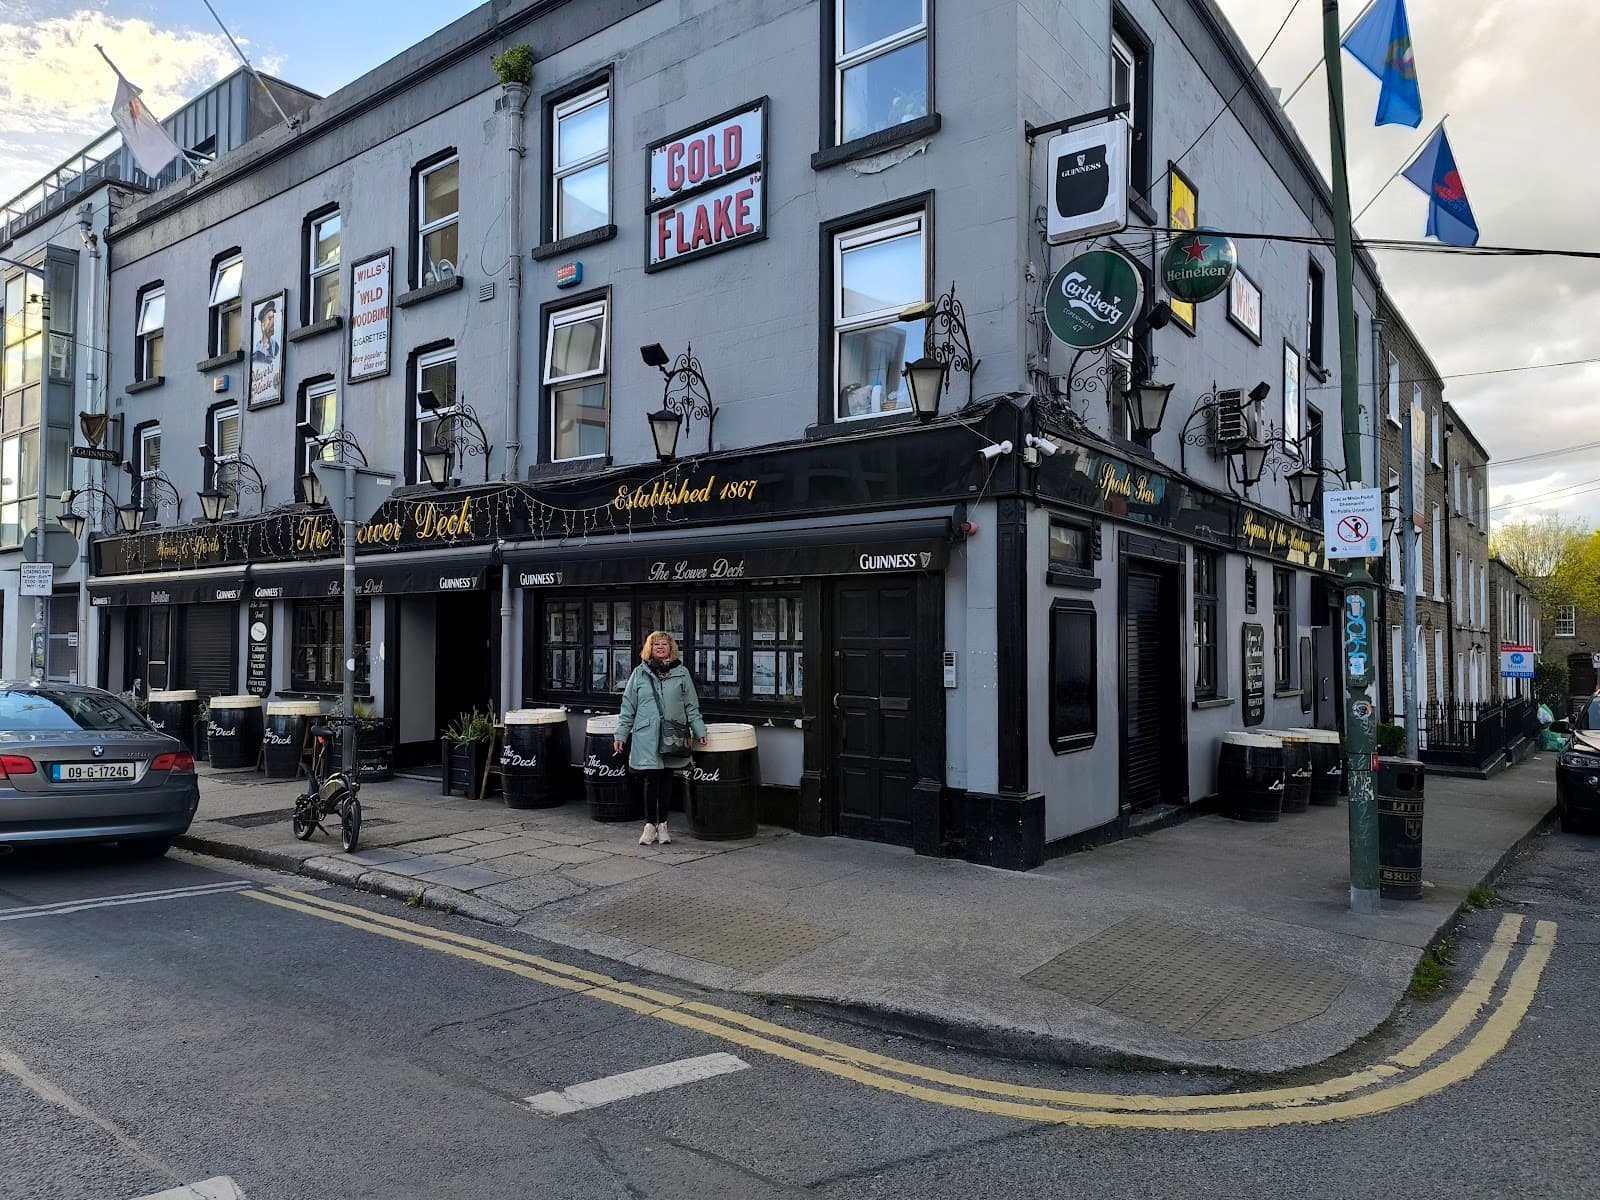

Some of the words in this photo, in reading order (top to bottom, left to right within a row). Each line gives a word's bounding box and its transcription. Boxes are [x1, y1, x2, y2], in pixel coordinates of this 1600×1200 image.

[1061, 161, 1102, 178] GUINNESS
[1166, 265, 1227, 282] Heineken
[1061, 271, 1123, 325] Carlsberg
[76, 447, 115, 459] GUINNESS
[1100, 462, 1131, 501] Sports
[1135, 475, 1155, 504] Bar
[614, 475, 716, 510] Established
[719, 479, 758, 501] 1867
[296, 516, 331, 551] The
[342, 519, 401, 546] ower
[414, 496, 473, 540] Deck
[860, 553, 917, 570] GUINNESS
[648, 562, 669, 581] The
[672, 560, 707, 580] Lower
[710, 558, 745, 578] Deck
[439, 577, 470, 589] GUINNESS
[520, 572, 554, 586] GUINNESS
[254, 587, 279, 598] GUINNESS
[363, 578, 384, 594] Deck
[216, 590, 237, 600] GUINNESS
[215, 726, 236, 737] Deck
[272, 734, 292, 745] Deck
[503, 745, 515, 757] The
[512, 754, 537, 767] Deck
[588, 754, 601, 767] The
[68, 766, 129, 778] 09-G-17246
[598, 764, 626, 777] Deck
[693, 767, 720, 781] Deck
